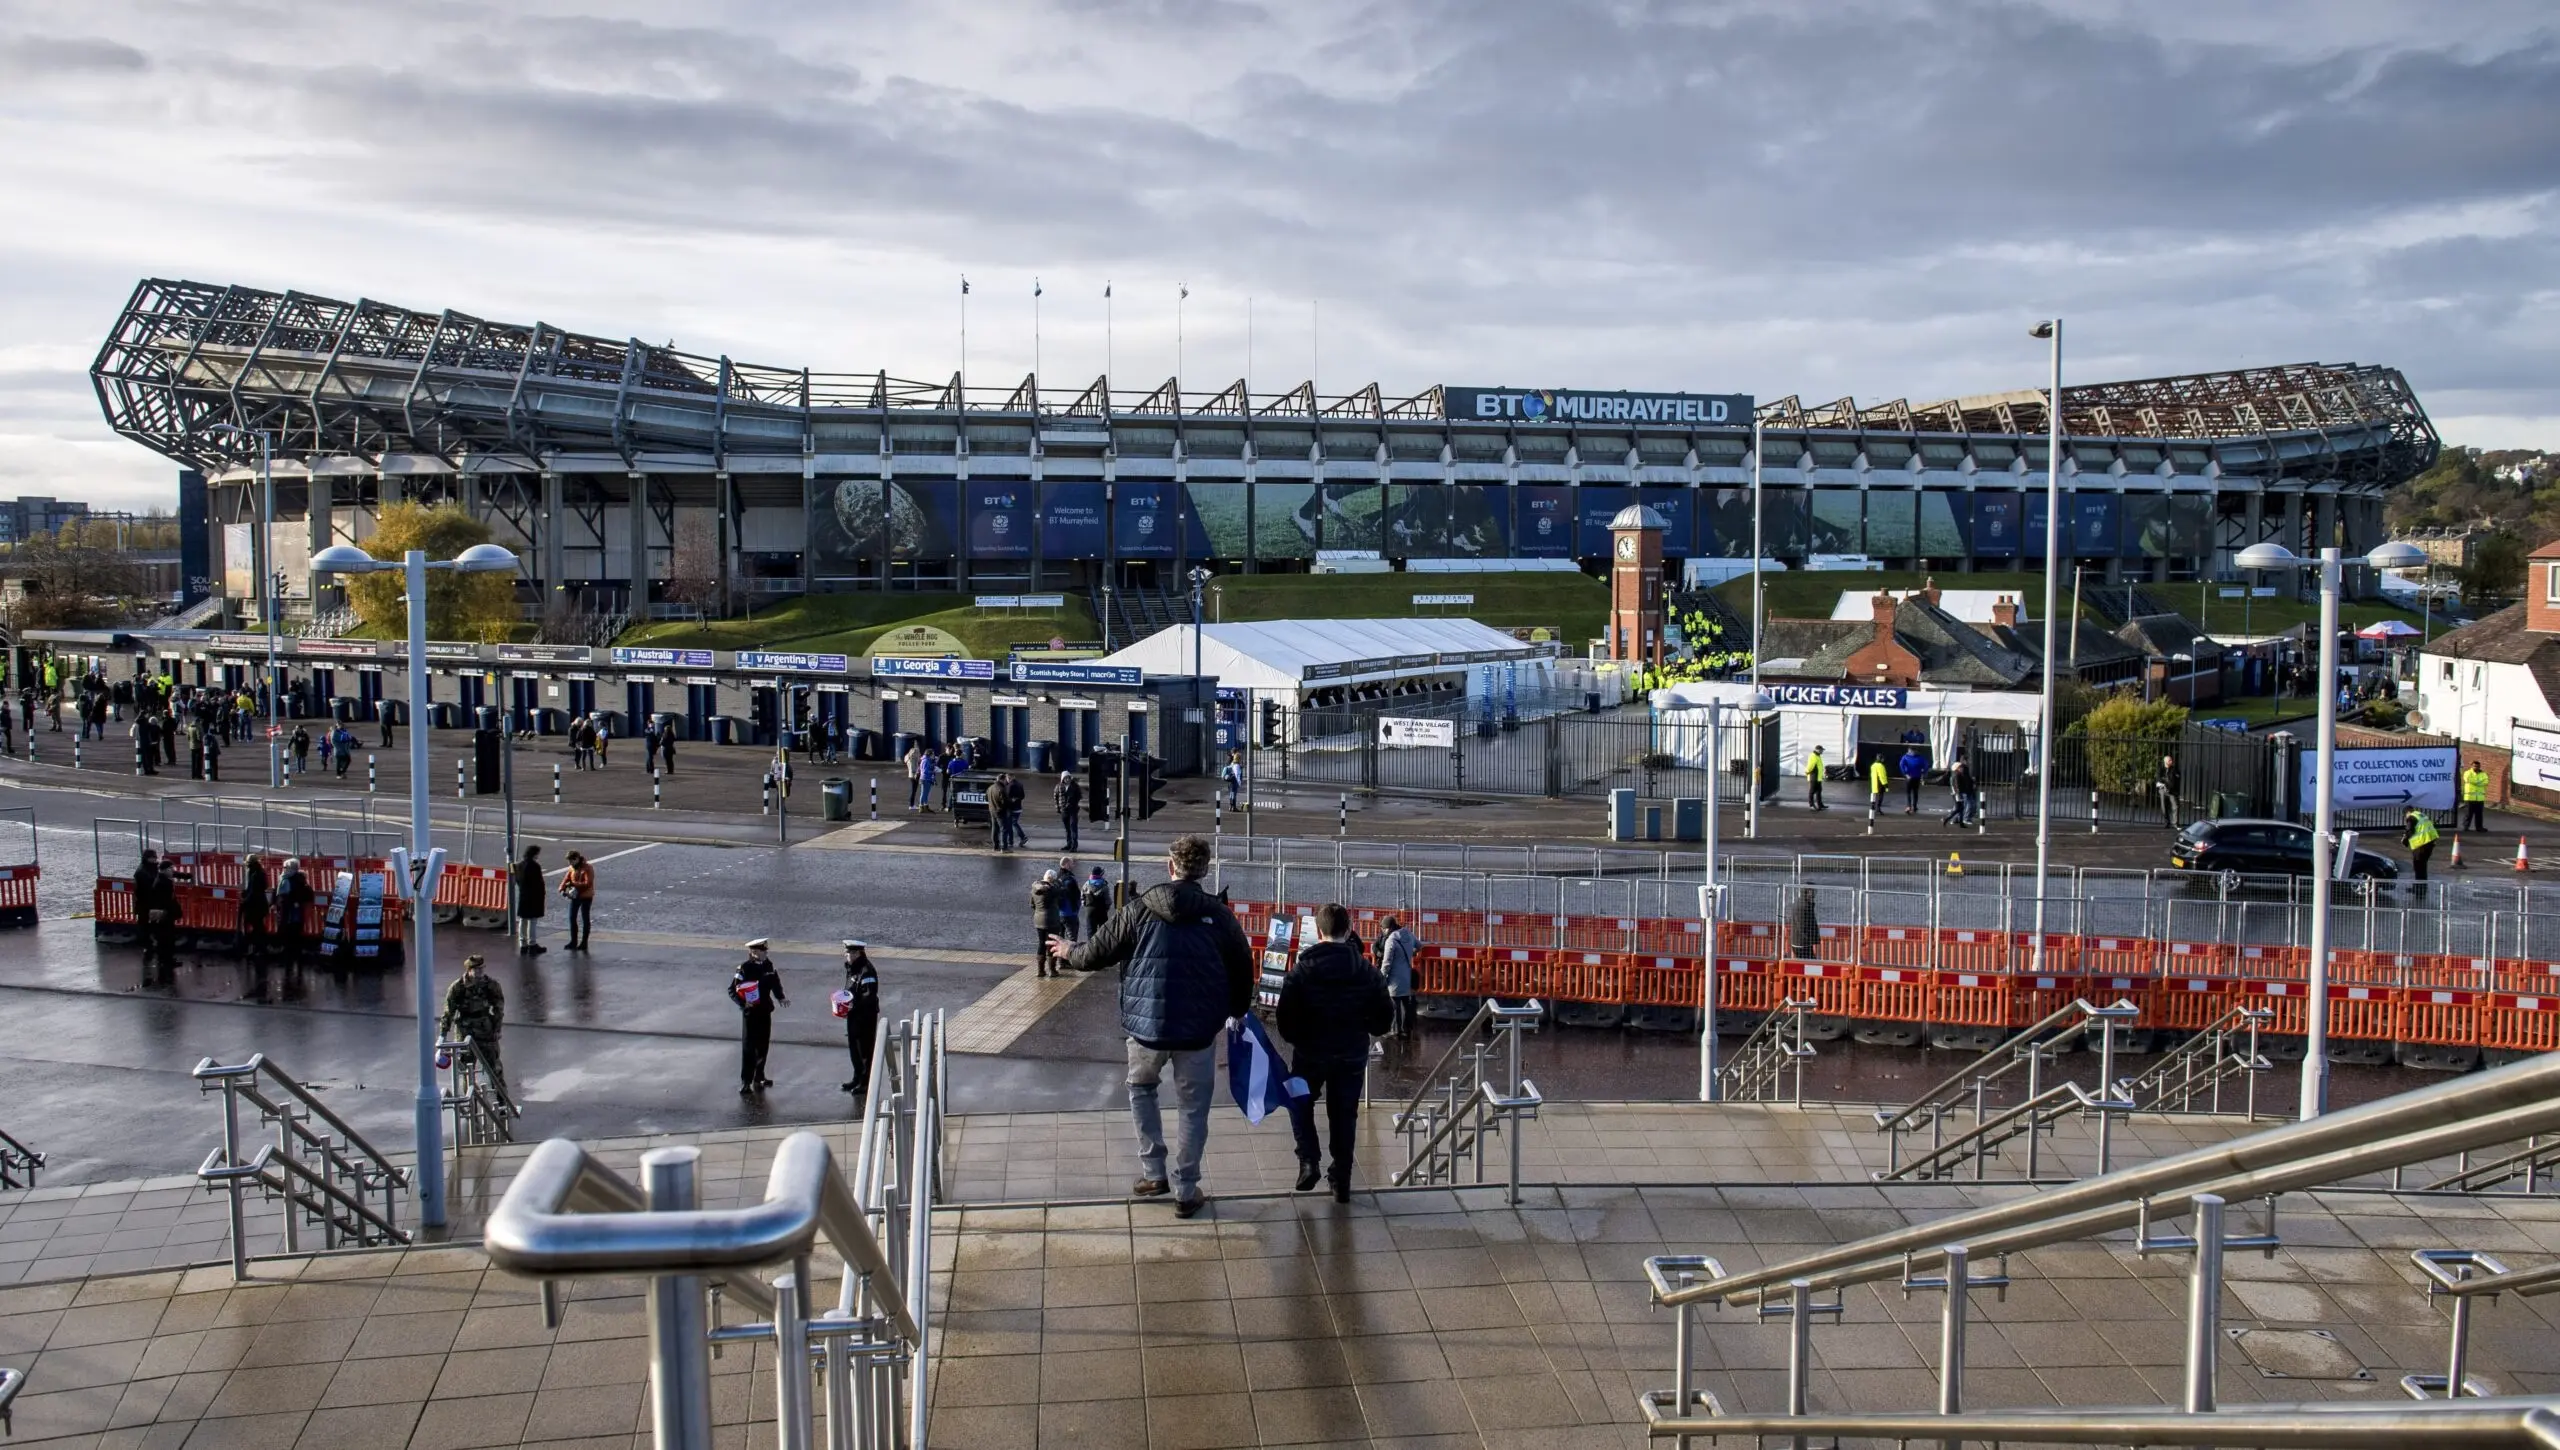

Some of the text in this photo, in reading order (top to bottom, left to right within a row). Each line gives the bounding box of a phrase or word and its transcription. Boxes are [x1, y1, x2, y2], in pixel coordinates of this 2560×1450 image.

[1476, 393, 1728, 422] BT MURRAYFIELD
[984, 497, 1000, 505] BT
[1131, 498, 1145, 506] BT
[1059, 516, 1098, 526] Murrayfield
[190, 576, 211, 584] SOU
[192, 585, 211, 593] STA
[630, 650, 673, 660] v Australia
[764, 655, 807, 666] Argentina
[895, 660, 940, 673] v Georgia
[1030, 669, 1085, 678] Scottish Rugby Store
[1769, 686, 1897, 707] TICKET SALES
[2517, 737, 2537, 748] TICKET
[2353, 759, 2418, 770] COLLECTIONS
[2422, 758, 2445, 768] ONLY
[2337, 772, 2452, 785] ACCREDITATION CENTRE
